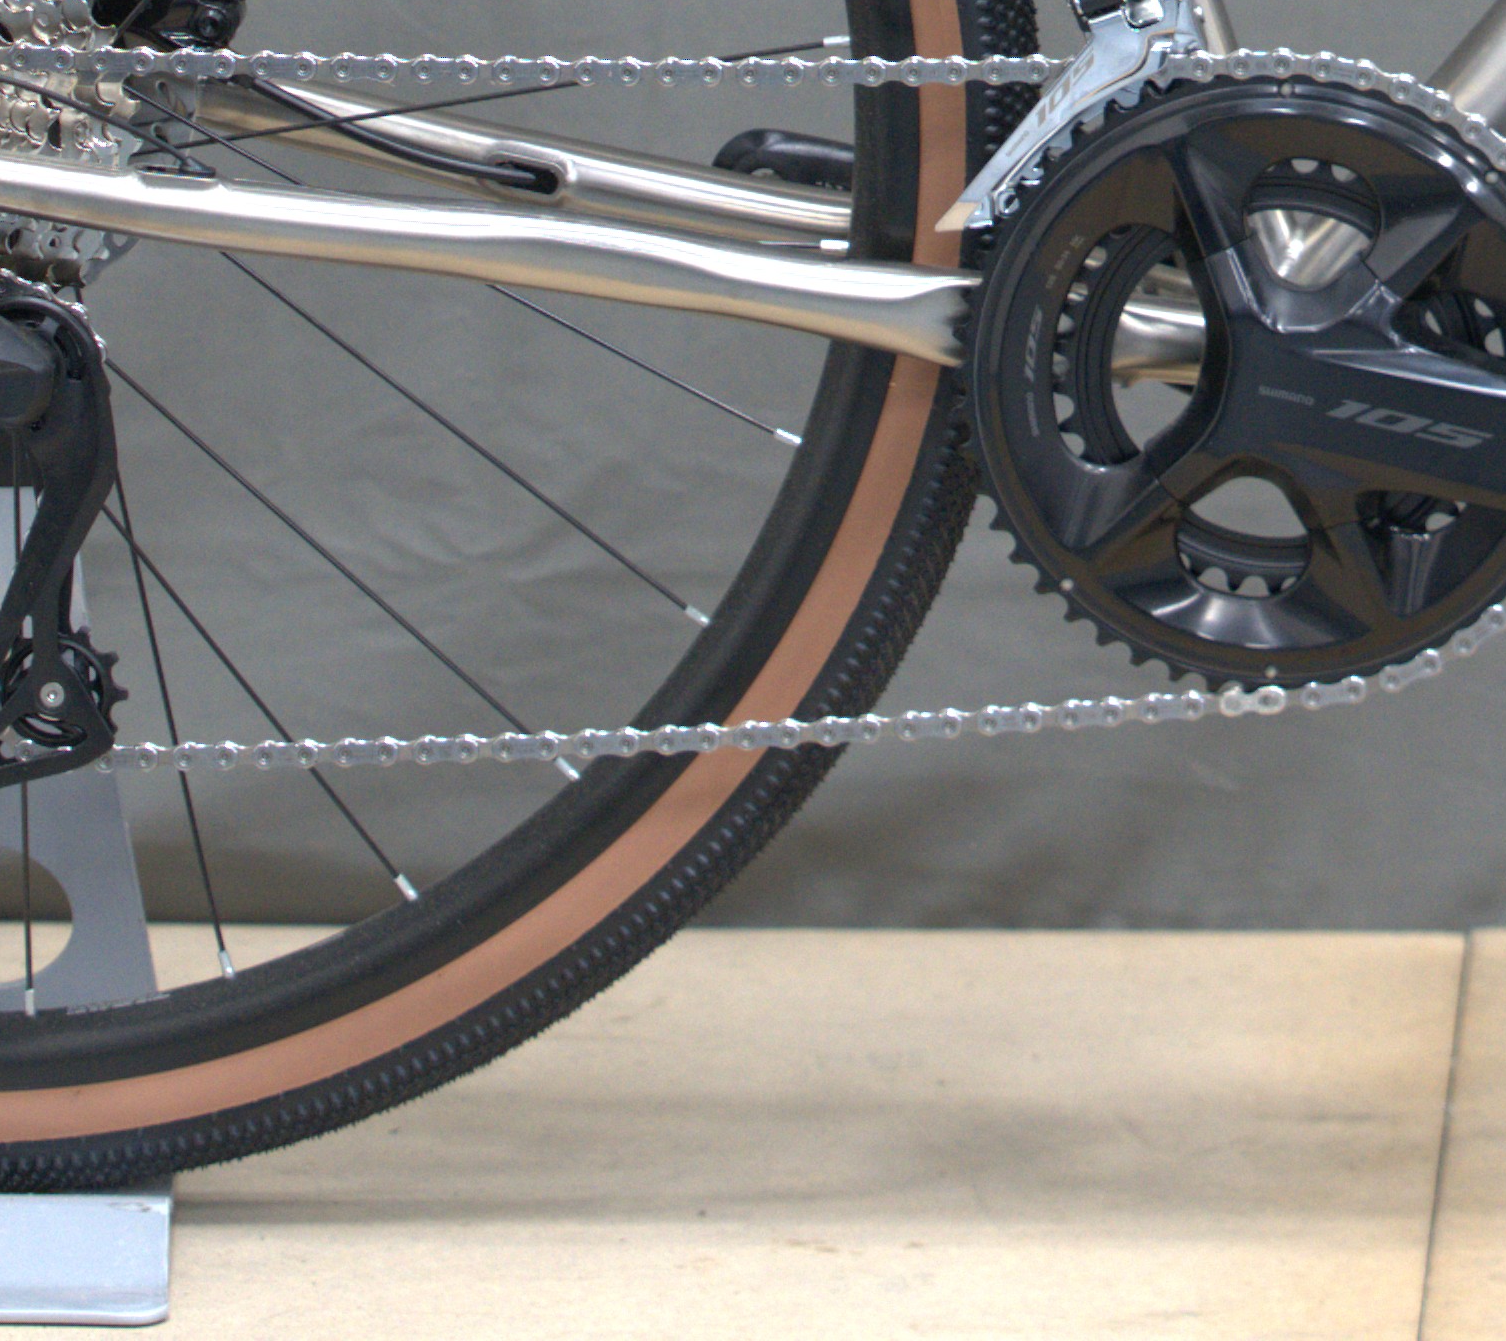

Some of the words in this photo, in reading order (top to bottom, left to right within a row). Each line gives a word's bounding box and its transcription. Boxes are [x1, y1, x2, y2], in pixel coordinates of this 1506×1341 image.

[1037, 46, 1094, 128] 105
[1025, 304, 1043, 383] 105
[1258, 384, 1315, 407] SHIMANO
[1325, 398, 1494, 451] 105
